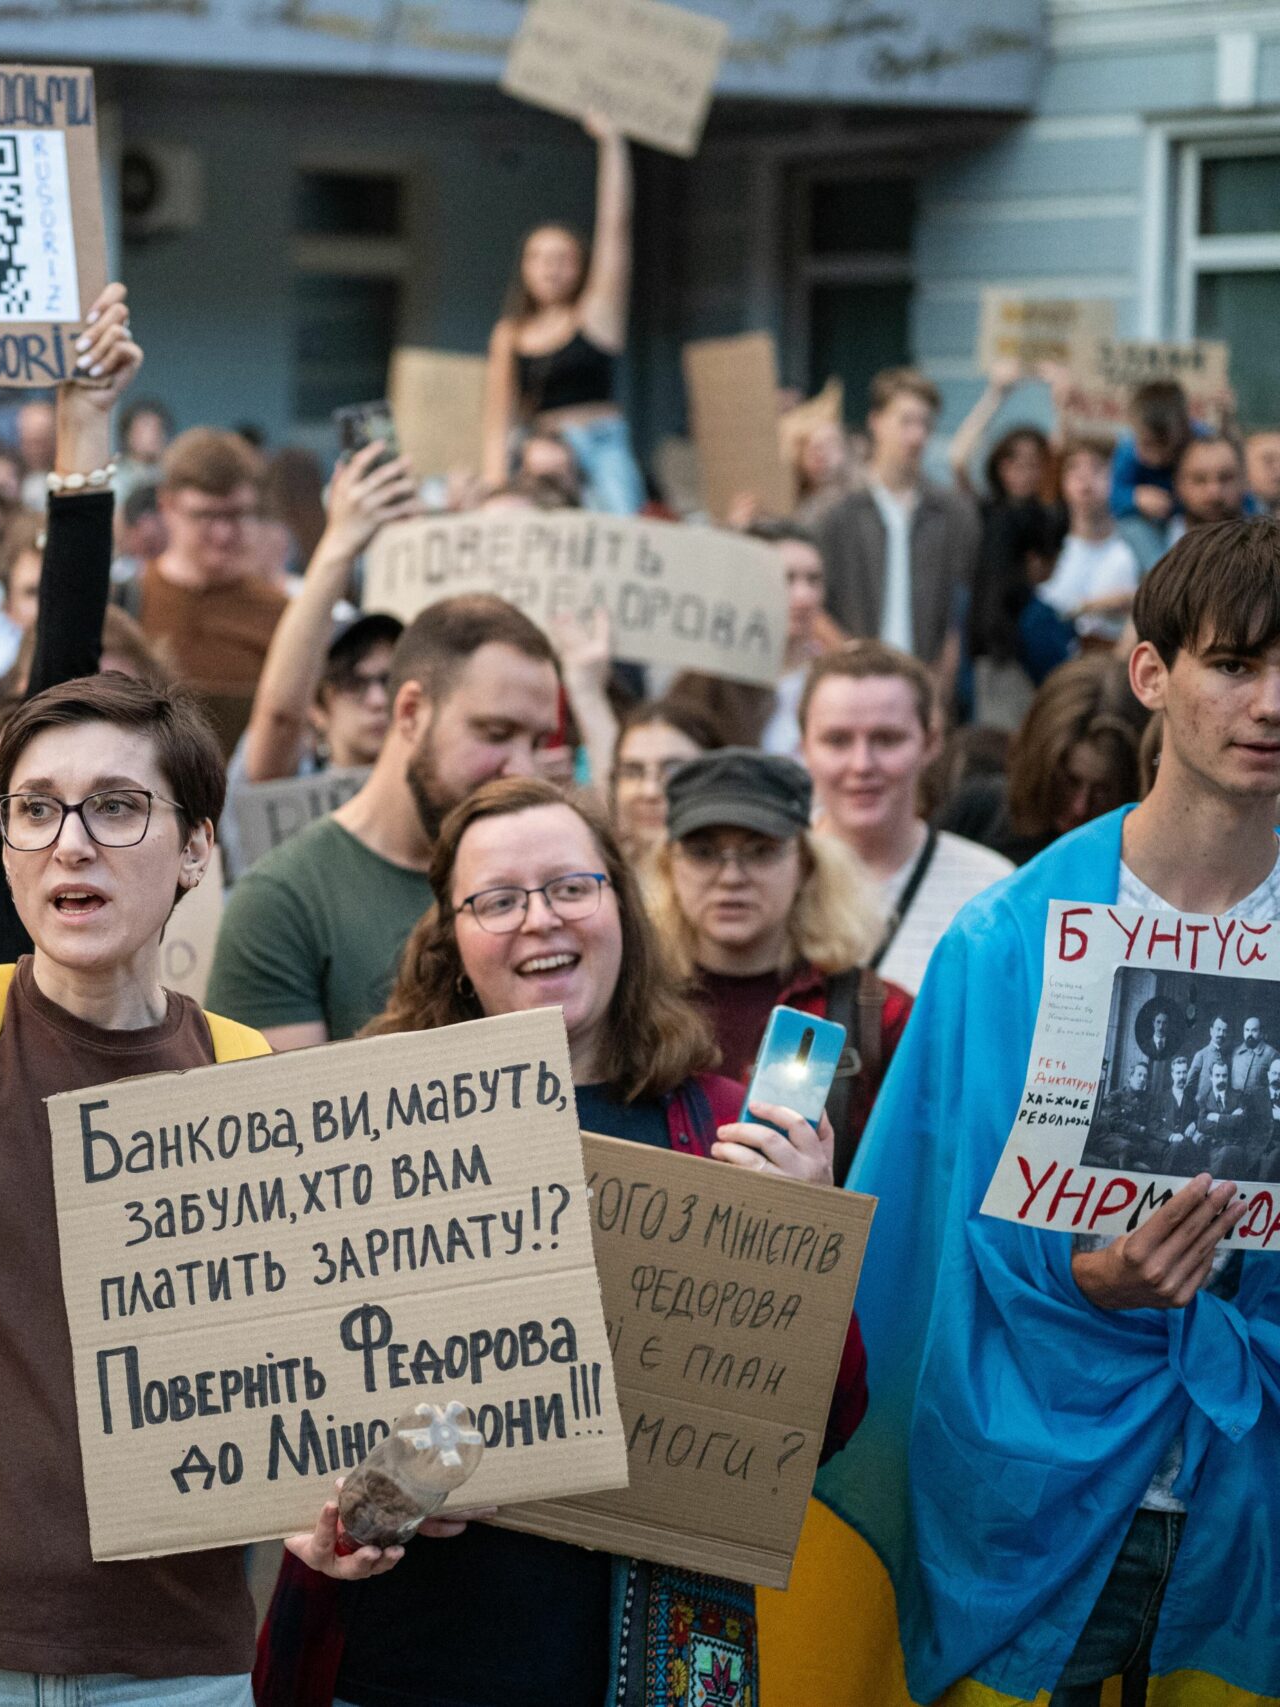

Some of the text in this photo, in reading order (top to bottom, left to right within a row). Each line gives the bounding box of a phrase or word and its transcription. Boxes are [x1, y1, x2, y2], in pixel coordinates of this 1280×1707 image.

[384, 520, 663, 594] ПОВЕРНІТЬ
[704, 1202, 846, 1275] МІНІСТРІВ
[631, 1265, 803, 1330] ФЕДОРОВА
[640, 1336, 664, 1370] Є
[683, 1344, 787, 1397] ПЛАН
